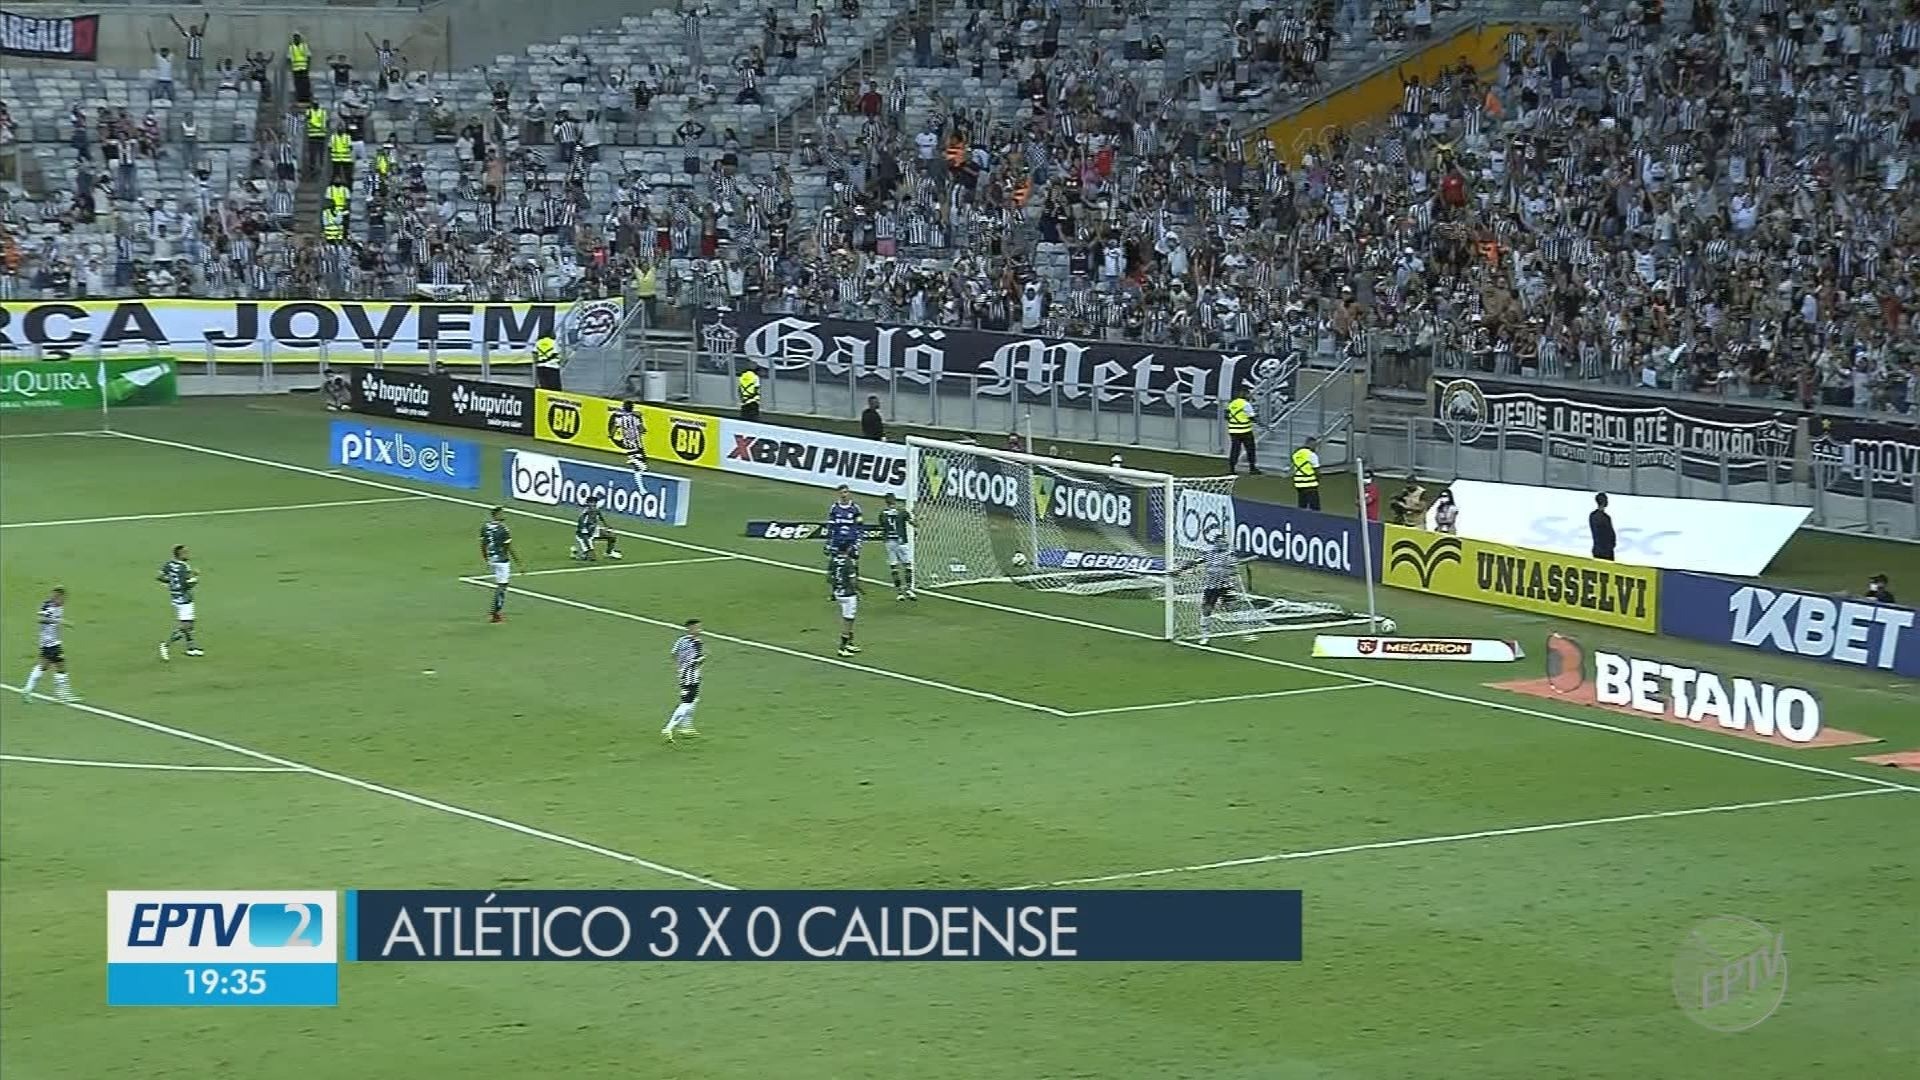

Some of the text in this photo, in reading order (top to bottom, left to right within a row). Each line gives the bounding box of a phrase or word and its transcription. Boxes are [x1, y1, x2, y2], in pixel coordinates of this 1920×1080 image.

[203, 303, 556, 349] JOVEM
[379, 379, 429, 406] hapvida
[976, 339, 1248, 410] Metal
[470, 391, 522, 417] hapvida
[553, 408, 576, 434] BH
[676, 428, 701, 455] BH
[1493, 402, 1547, 431] DESDE
[1554, 407, 1564, 434] O
[1634, 411, 1668, 443] ATÉ
[1673, 423, 1685, 449] O
[1692, 427, 1755, 457] CAIXÃO
[341, 429, 456, 477] pixbet
[727, 434, 907, 487] XBRI PNEUS
[947, 466, 1018, 507] SICOOB
[1054, 484, 1132, 527] SICOOB
[1081, 552, 1153, 571] GERDAU
[1476, 551, 1648, 618] UNIASSELVI
[1385, 643, 1468, 654] MEGATRON
[1729, 586, 1916, 669] 1XBET
[1594, 651, 1820, 743] BETANO
